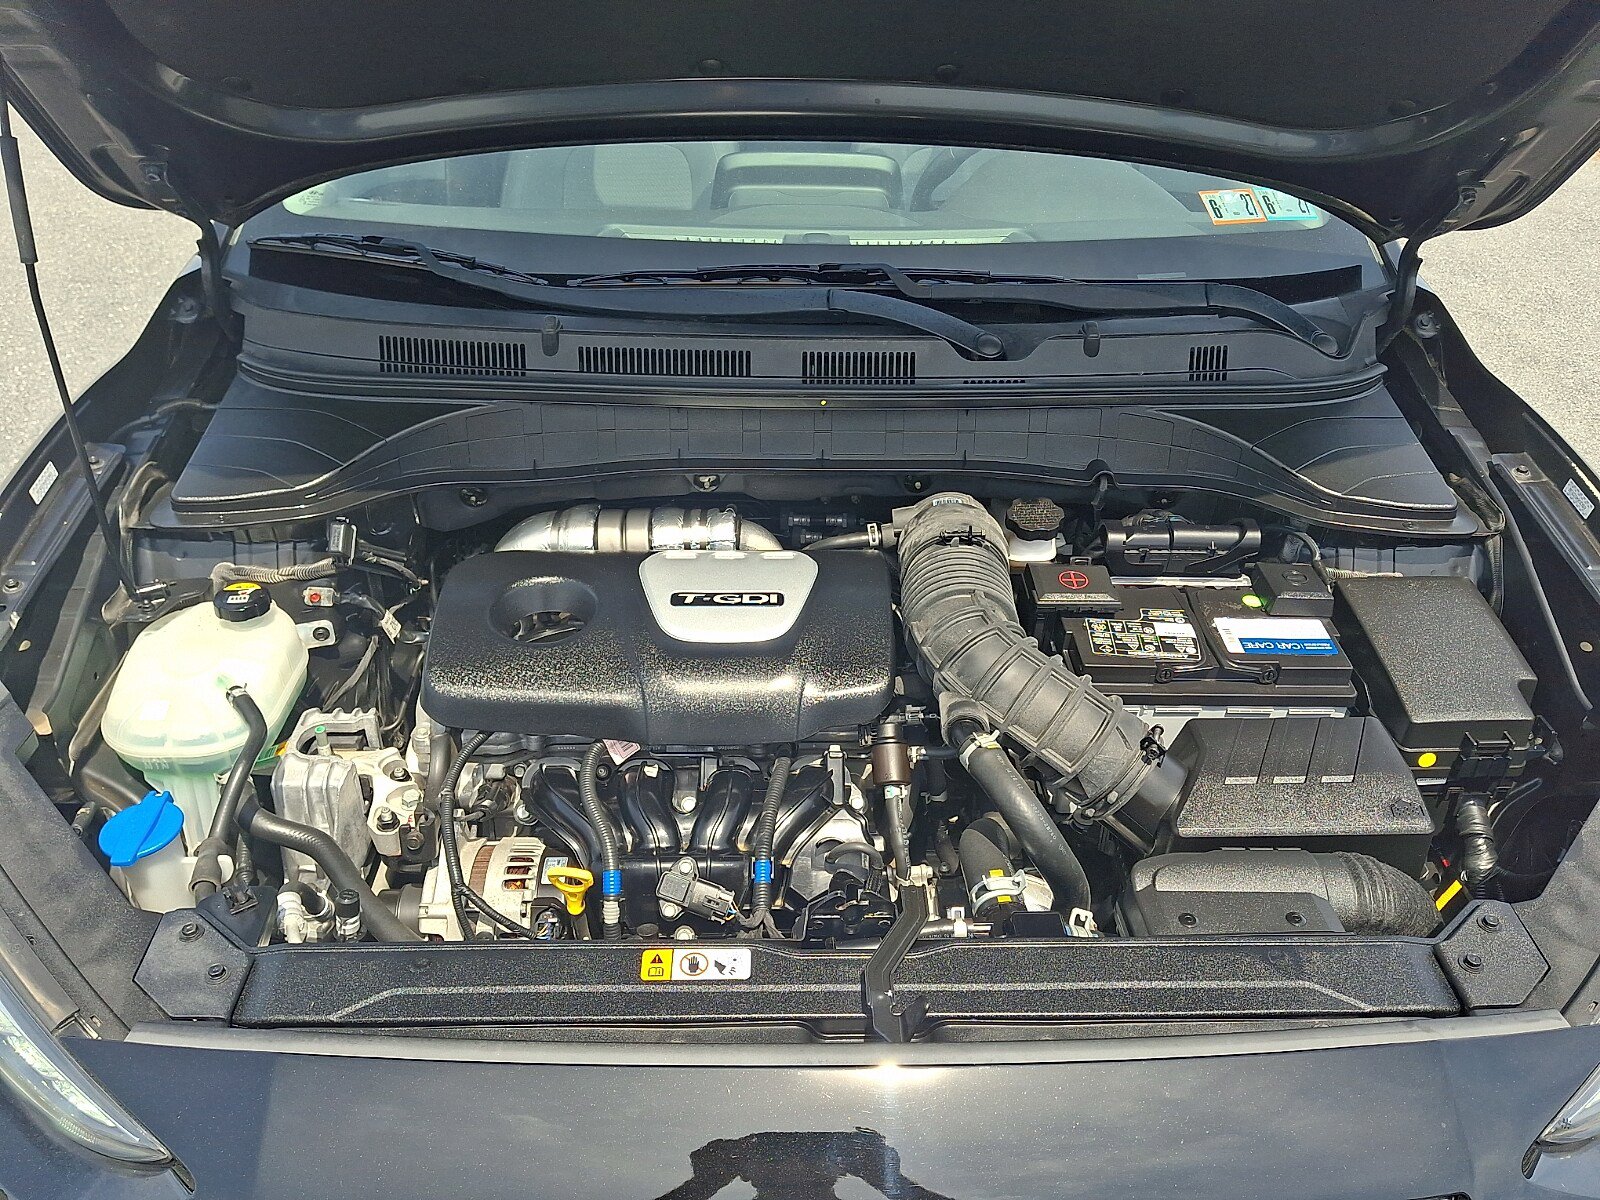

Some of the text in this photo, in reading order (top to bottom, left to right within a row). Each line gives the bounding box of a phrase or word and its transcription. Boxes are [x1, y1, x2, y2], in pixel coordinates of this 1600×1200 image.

[678, 593, 778, 605] T-GDI
[1242, 642, 1274, 650] CARE
[1276, 642, 1300, 650] CAR
